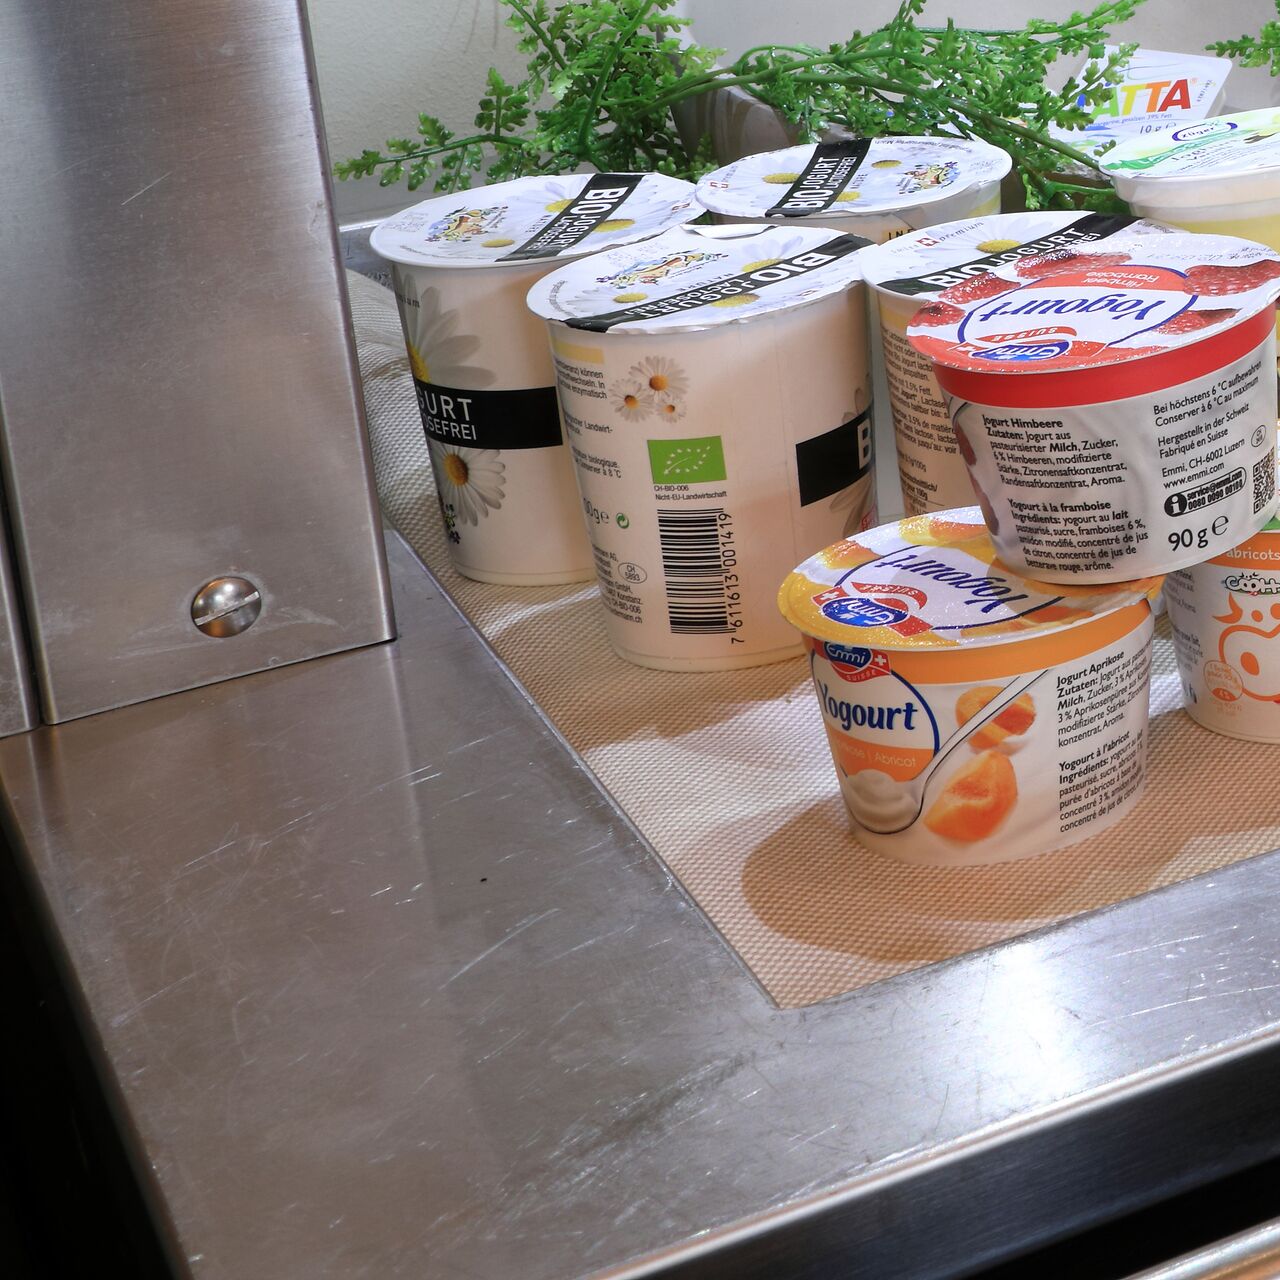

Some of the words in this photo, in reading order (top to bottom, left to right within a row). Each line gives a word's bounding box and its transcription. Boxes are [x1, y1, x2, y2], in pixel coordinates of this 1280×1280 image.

[1139, 124, 1152, 135] 10
[799, 157, 840, 189] JOGURT
[585, 186, 629, 214] BIO
[782, 189, 833, 209] BIO
[559, 213, 600, 254] JOGURT
[757, 252, 837, 282] BIO
[916, 263, 988, 288] BIO
[990, 228, 1085, 267] JOGURT
[624, 278, 746, 316] LACTOSEFREI
[646, 280, 757, 318] JOGURT
[979, 292, 1167, 322] Yogourt
[1169, 391, 1211, 412] höchstens
[1011, 419, 1063, 429] Himbeere
[1155, 408, 1200, 427] Conserver
[987, 427, 1023, 441] Zutaten:
[1158, 424, 1203, 448] Hergestellt
[990, 441, 1046, 453] pasteurisierter
[1050, 442, 1081, 453] Milch,
[1082, 439, 1118, 451] Zucker,
[1159, 440, 1196, 460] Fabriqué
[1007, 453, 1055, 466] Himbeeren,
[1056, 452, 1112, 464] modifizierte
[1022, 463, 1127, 477] Zitronensaftkonzentrat,
[1162, 463, 1188, 479] Emmi,
[1189, 446, 1224, 470] CH-6002
[1091, 476, 1125, 487] Aroma.
[1163, 463, 1225, 489] www.emmi.com
[1187, 470, 1243, 501] service@emmi.com
[655, 490, 728, 501] Nicht-EU-Landwirtschaft
[1060, 501, 1111, 512] framboise
[718, 513, 738, 567] 001419
[1078, 524, 1125, 536] framboises
[1168, 528, 1194, 552] 90
[1077, 536, 1121, 548] concentré
[1056, 548, 1096, 559] concentré
[874, 553, 1029, 614] Yogourt
[724, 574, 744, 628] 611613
[826, 642, 866, 664] Emmi
[845, 669, 877, 681] SUISSE
[1056, 668, 1088, 689] Jogurt
[1089, 650, 1125, 676] Aprikose
[1057, 677, 1099, 699] Zutaten:
[817, 678, 918, 731] Yogourt
[1058, 711, 1105, 736] modifizierte
[874, 751, 917, 768] Abricot
[1059, 751, 1095, 771] Yogourt
[1059, 757, 1109, 784] Ingrédients:
